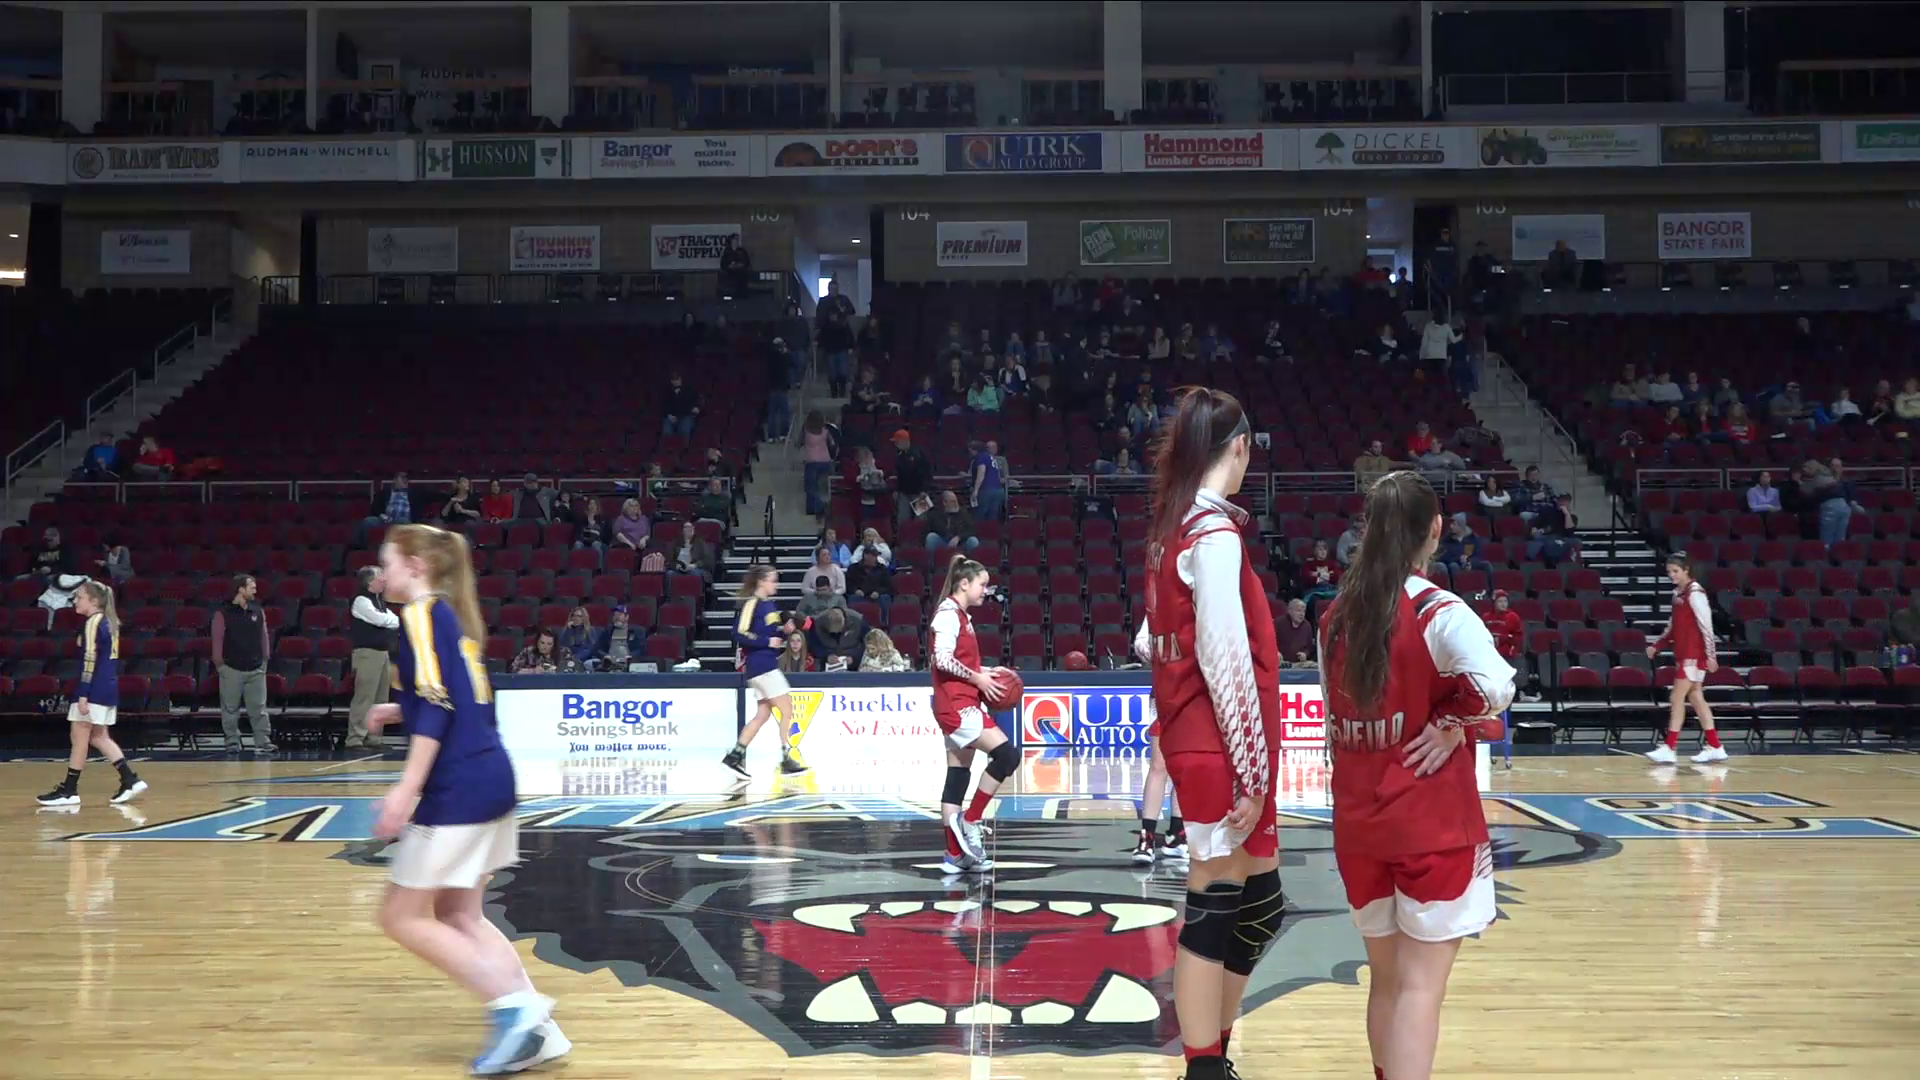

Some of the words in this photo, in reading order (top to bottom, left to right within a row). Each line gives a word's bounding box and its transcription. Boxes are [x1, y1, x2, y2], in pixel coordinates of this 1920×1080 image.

[826, 139, 918, 156] DORR'S
[1144, 132, 1263, 152] Hammond
[1354, 132, 1444, 150] DICKEL
[247, 148, 308, 158] RUDMAN
[319, 146, 391, 157] WINCHELL
[459, 144, 528, 164] HUSSON
[604, 140, 672, 159] Bangor
[998, 157, 1036, 169] AUTO
[1039, 156, 1086, 169] GROUP
[1148, 155, 1194, 165] Lumber
[1198, 155, 1260, 167] Company
[1124, 226, 1164, 240] Follow
[1663, 221, 1744, 236] BANGOR
[679, 236, 729, 247] TRACTO
[942, 235, 1021, 254] PREMIUM
[1664, 239, 1705, 250] STATE
[1711, 238, 1746, 249] FAIR
[536, 247, 592, 259] DONUTS
[678, 247, 723, 258] SUPPLY
[562, 694, 673, 724] Bangor
[831, 694, 917, 712] Buckle
[557, 722, 628, 739] Savings
[632, 721, 678, 735] Bank
[840, 720, 865, 735] No
[1076, 726, 1136, 745] AUTO
[569, 742, 589, 753] You
